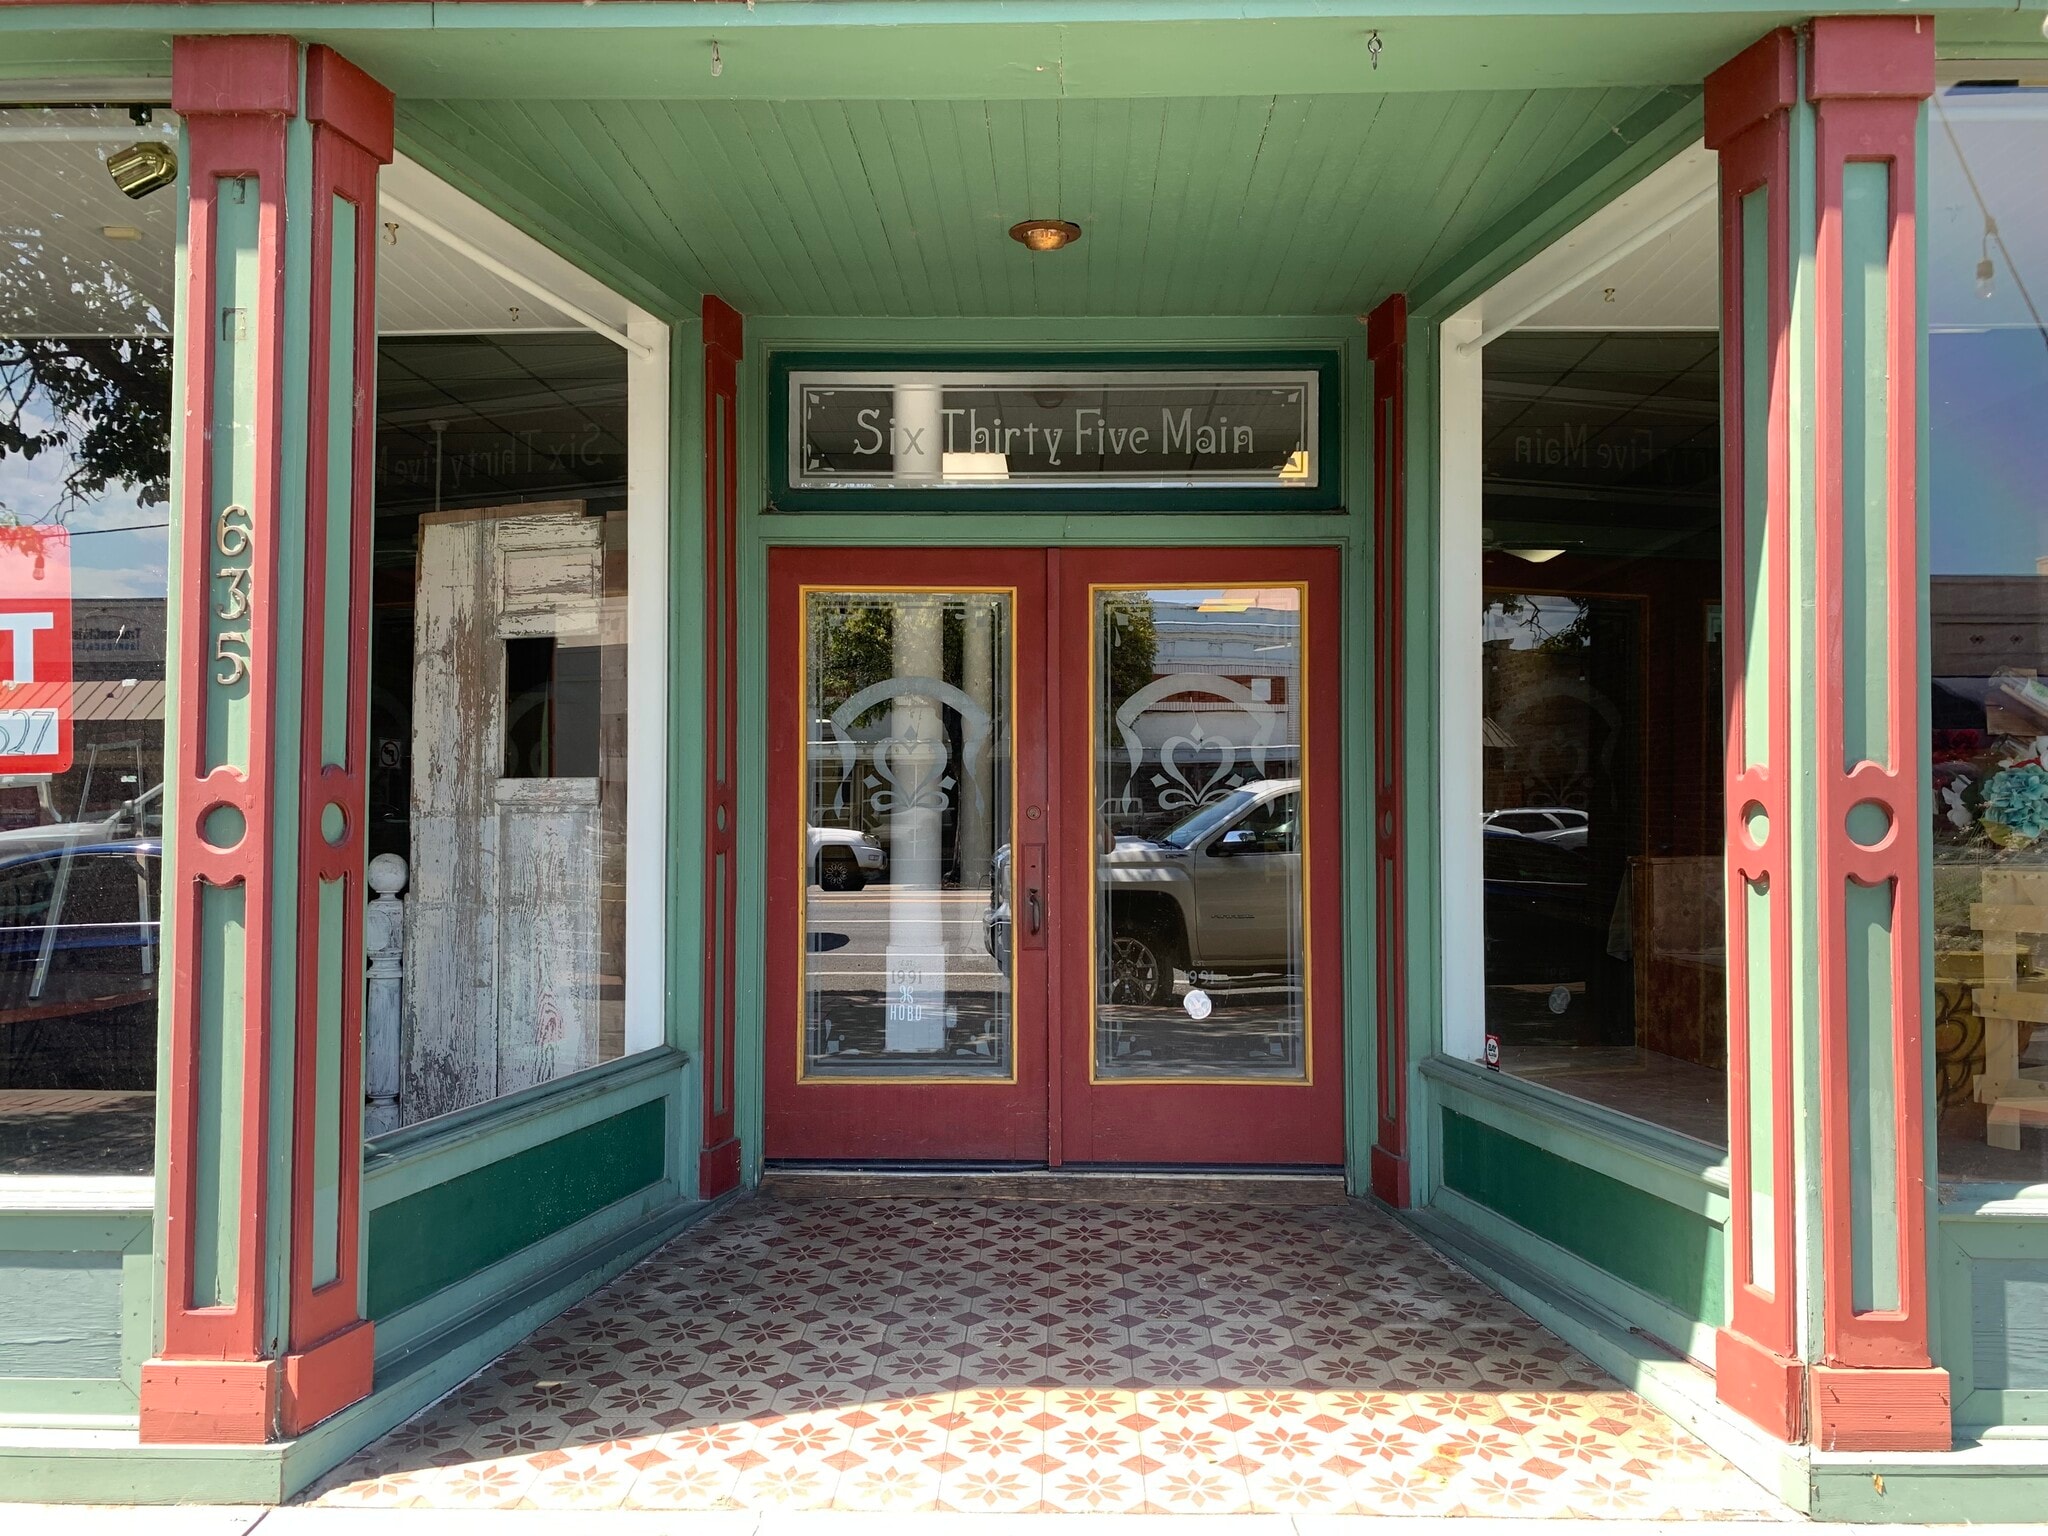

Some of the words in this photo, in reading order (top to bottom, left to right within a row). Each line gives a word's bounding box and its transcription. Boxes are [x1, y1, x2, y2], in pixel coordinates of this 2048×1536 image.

[853, 408, 926, 456] Six
[939, 408, 1061, 465] Thirty
[1074, 408, 1150, 456] Five
[1162, 408, 1255, 456] Main
[215, 505, 250, 686] 635
[891, 969, 923, 985] 1991
[890, 1004, 923, 1022] HOBO
